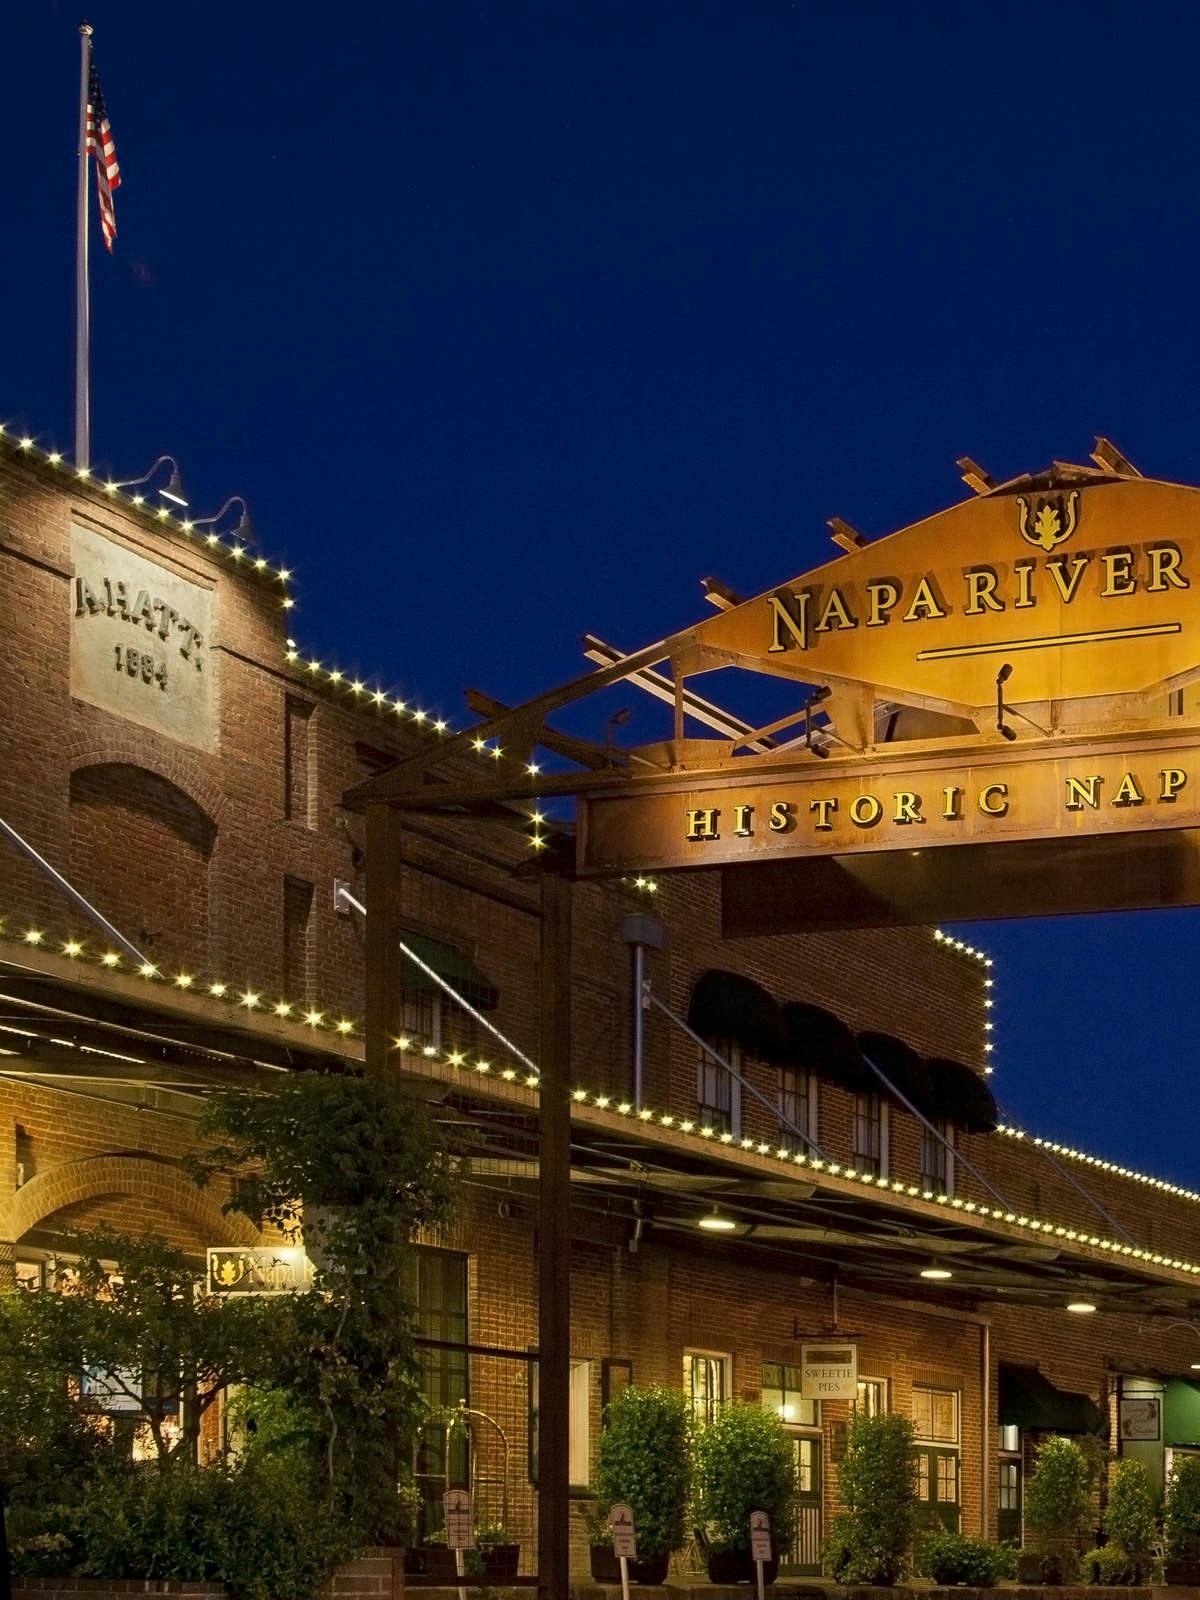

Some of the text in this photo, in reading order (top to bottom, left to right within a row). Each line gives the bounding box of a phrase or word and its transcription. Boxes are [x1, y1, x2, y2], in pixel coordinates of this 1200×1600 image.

[767, 575, 945, 653] NAPA
[964, 547, 1190, 616] RIVER
[114, 643, 168, 691] 1884
[685, 782, 1008, 842] HISTORIC
[247, 1255, 296, 1290] Napa
[804, 1368, 853, 1379] SWEETIE
[818, 1382, 841, 1392] PIES
